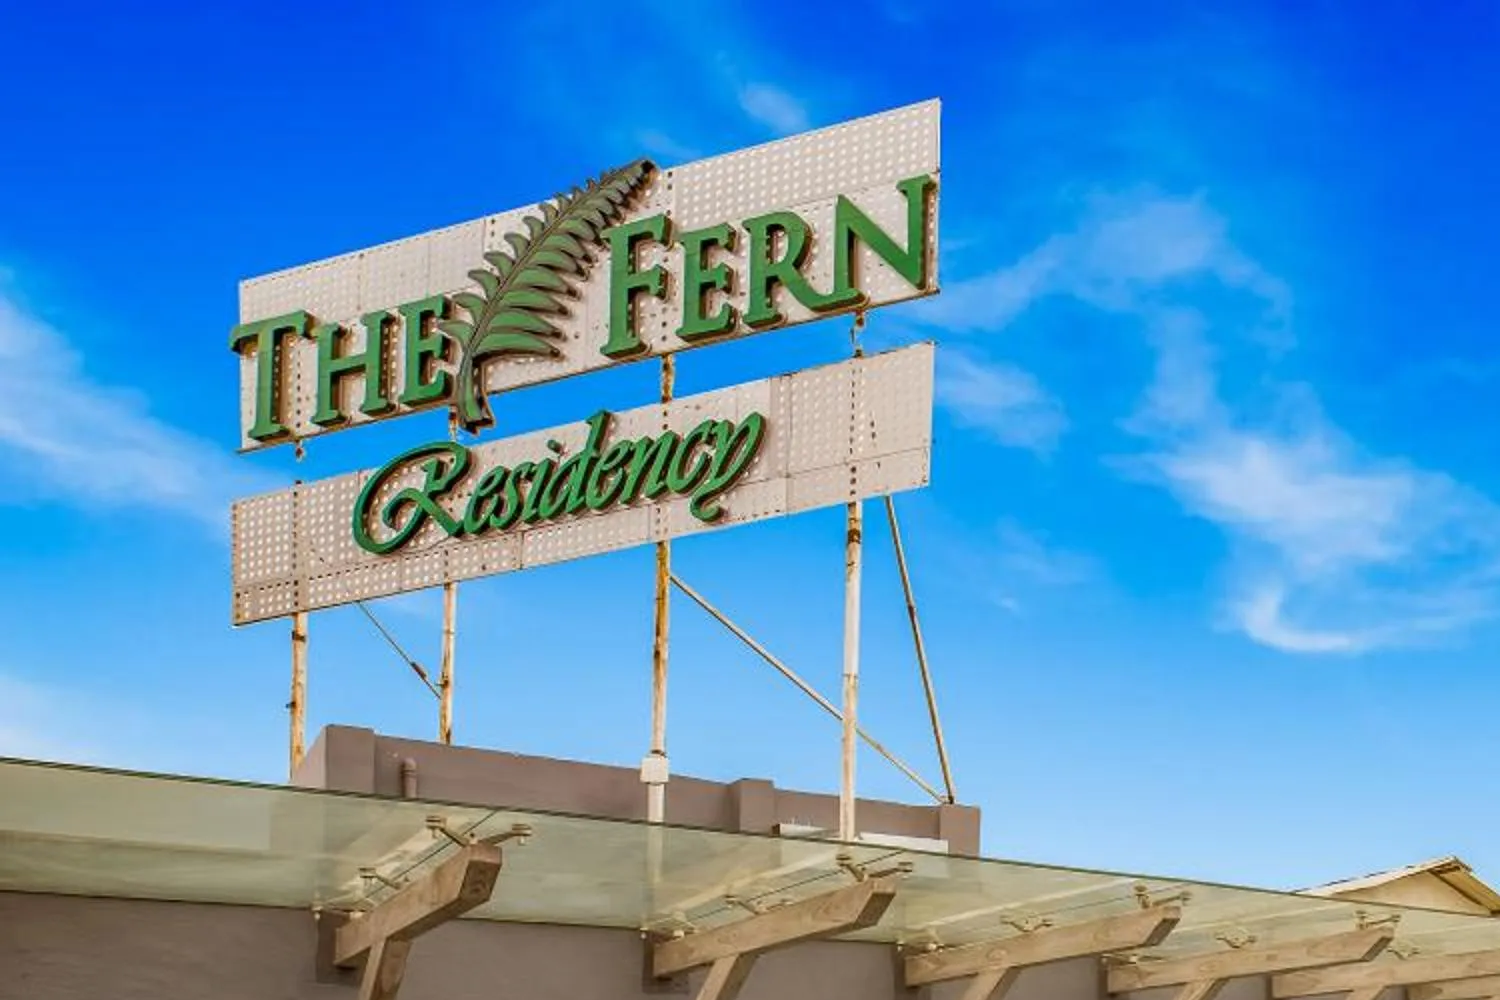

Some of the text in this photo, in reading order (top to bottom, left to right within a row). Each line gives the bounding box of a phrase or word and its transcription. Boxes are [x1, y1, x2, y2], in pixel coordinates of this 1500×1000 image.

[230, 174, 940, 442] THE FERN
[351, 410, 767, 555] Residency
